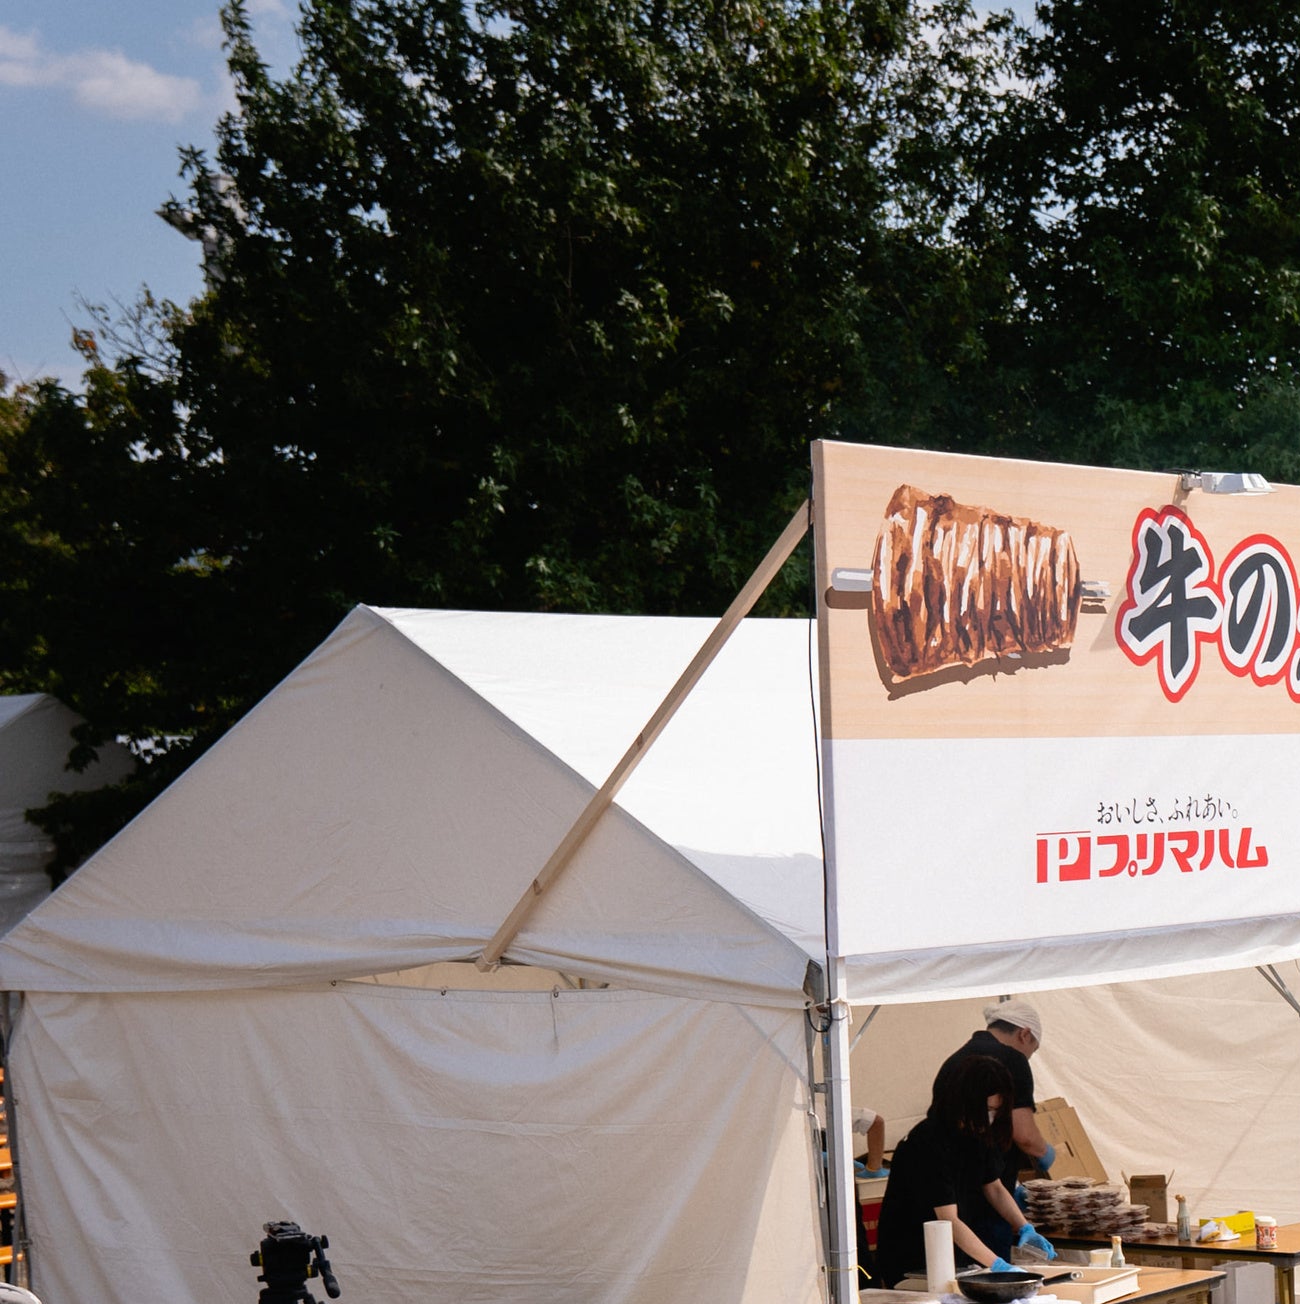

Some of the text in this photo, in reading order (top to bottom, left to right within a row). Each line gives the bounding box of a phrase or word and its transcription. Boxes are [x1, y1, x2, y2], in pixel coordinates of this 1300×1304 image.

[1097, 794, 1239, 825] おいしさ、ふれあい。
[1097, 827, 1269, 877] プリマハム
